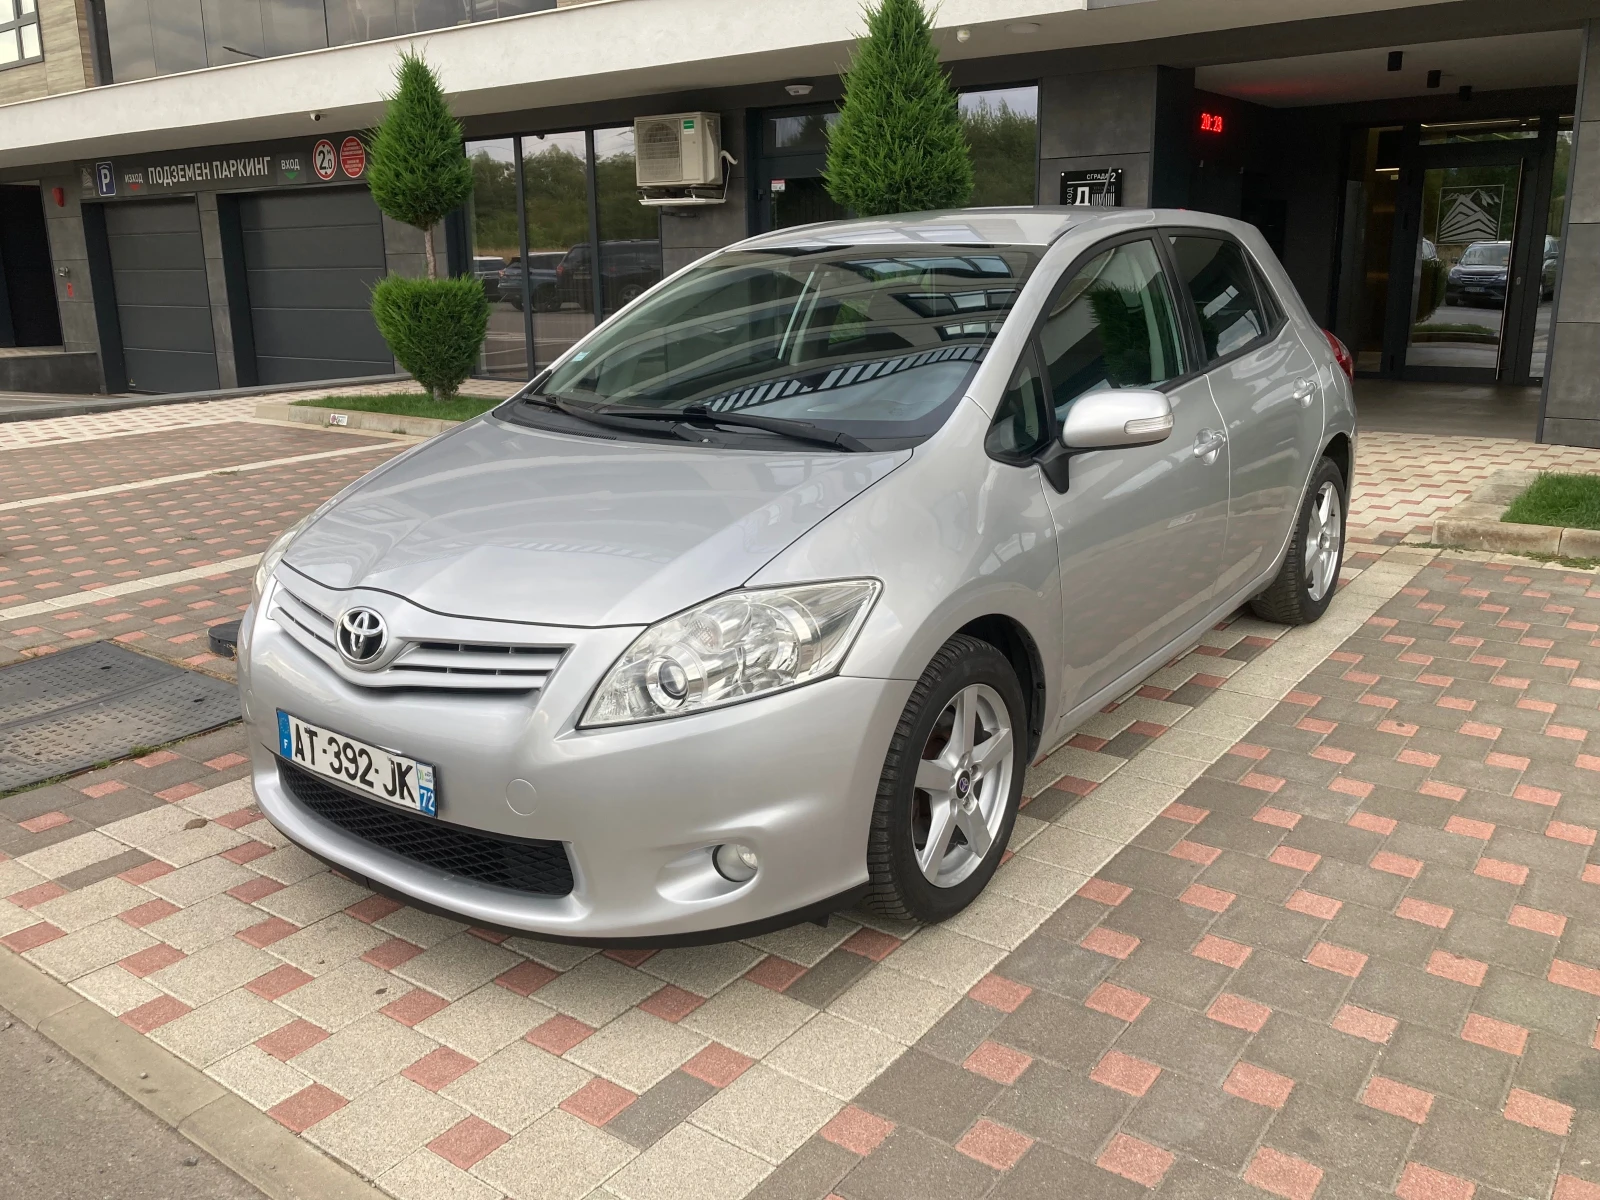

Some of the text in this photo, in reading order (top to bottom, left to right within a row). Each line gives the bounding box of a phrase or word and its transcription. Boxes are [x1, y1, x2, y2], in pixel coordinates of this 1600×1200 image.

[148, 156, 271, 187] ПОДЗЕМЕН ПАРКИНГ
[281, 158, 300, 171] ВХОД
[100, 168, 110, 192] P
[124, 173, 143, 183] ИЗХОД
[1110, 172, 1116, 182] 2
[1066, 187, 1074, 205] ХОД
[1073, 186, 1091, 206] Д
[283, 739, 289, 750] F
[294, 723, 416, 804] AT-392-JK
[420, 788, 435, 812] 72
